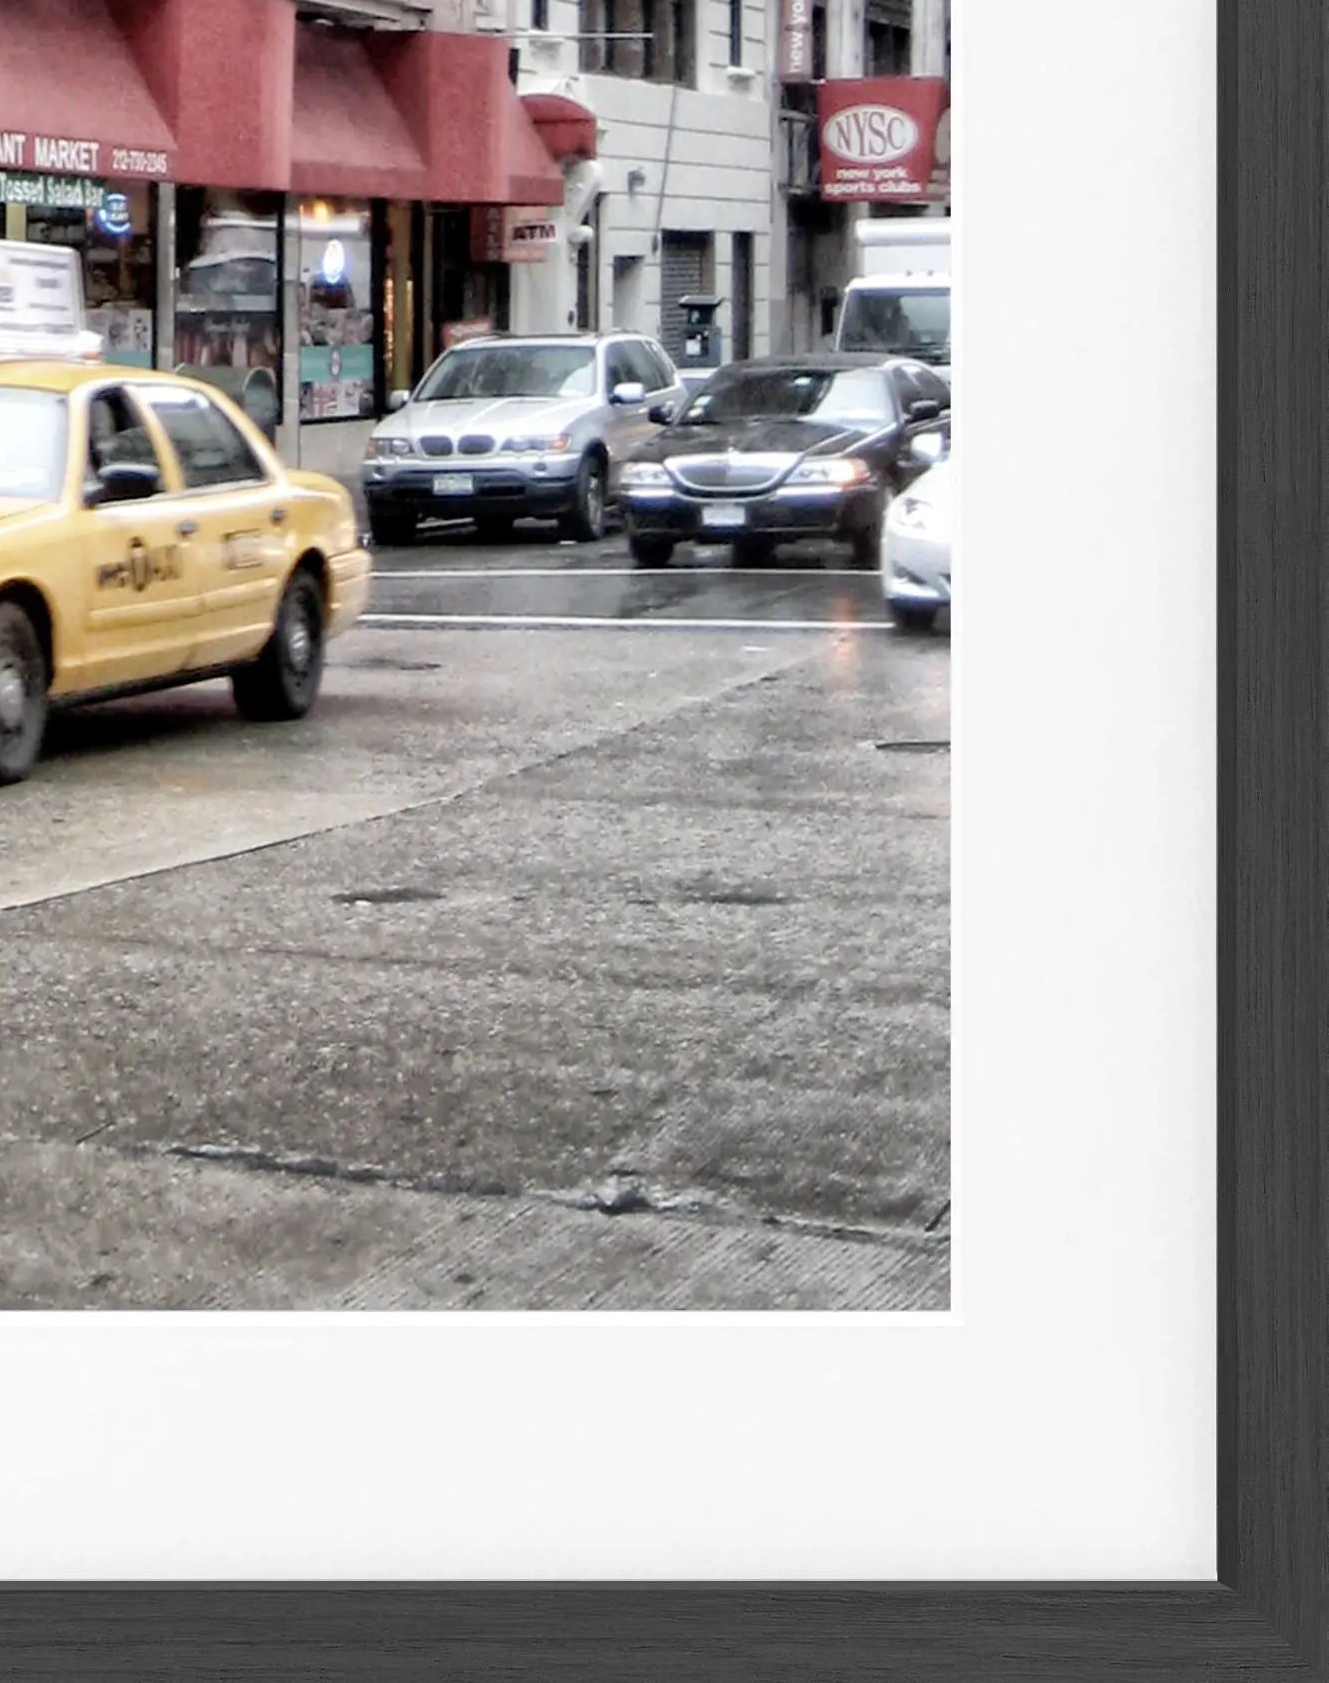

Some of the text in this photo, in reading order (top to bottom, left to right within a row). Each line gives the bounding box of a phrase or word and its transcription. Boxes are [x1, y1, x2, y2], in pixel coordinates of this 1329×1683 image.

[789, 31, 804, 73] new
[836, 111, 905, 157] NYSC
[34, 136, 99, 171] MARKET
[512, 224, 556, 240] ATM
